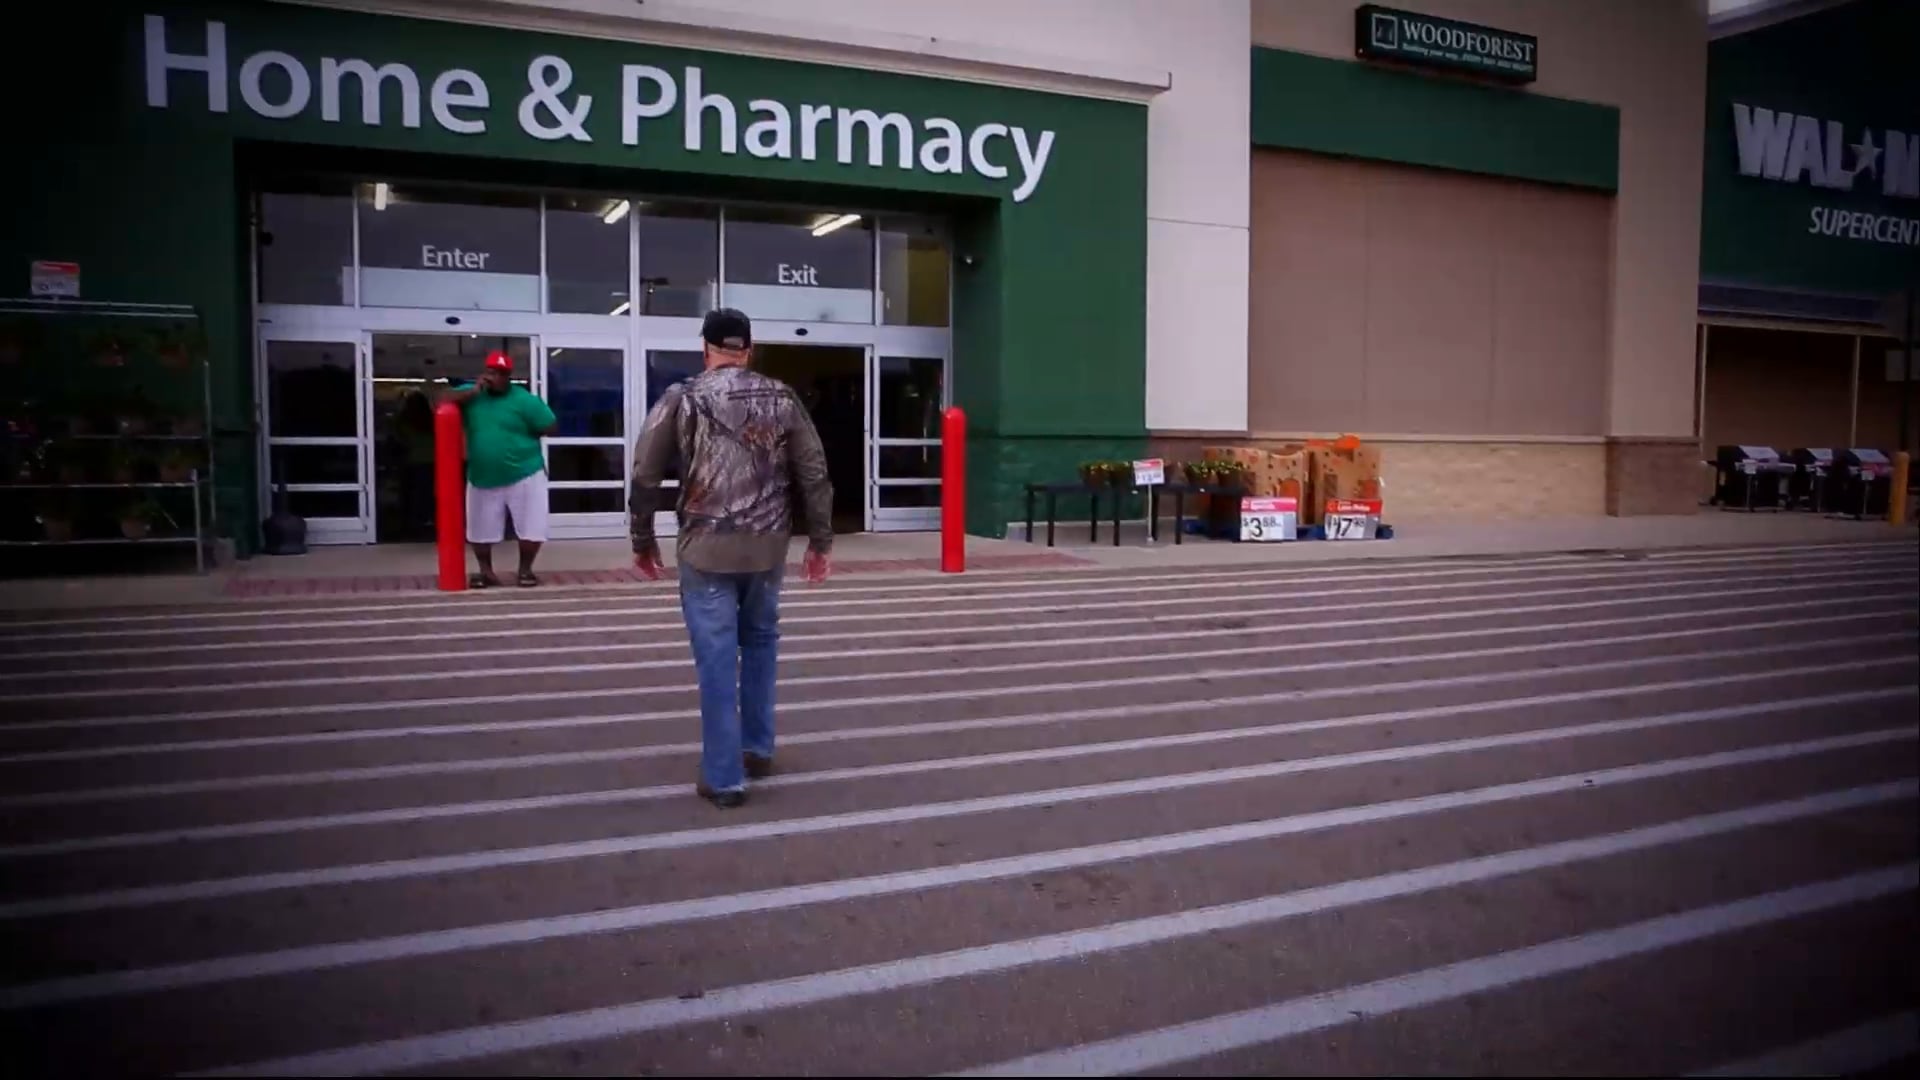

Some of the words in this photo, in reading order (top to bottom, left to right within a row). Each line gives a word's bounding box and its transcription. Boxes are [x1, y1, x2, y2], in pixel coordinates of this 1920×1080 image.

[1403, 19, 1534, 62] WOODFOREST
[144, 14, 490, 134] Home
[518, 55, 593, 142] &
[622, 64, 1055, 202] Pharmacy
[422, 245, 490, 270] Enter
[778, 263, 818, 286] Exit
